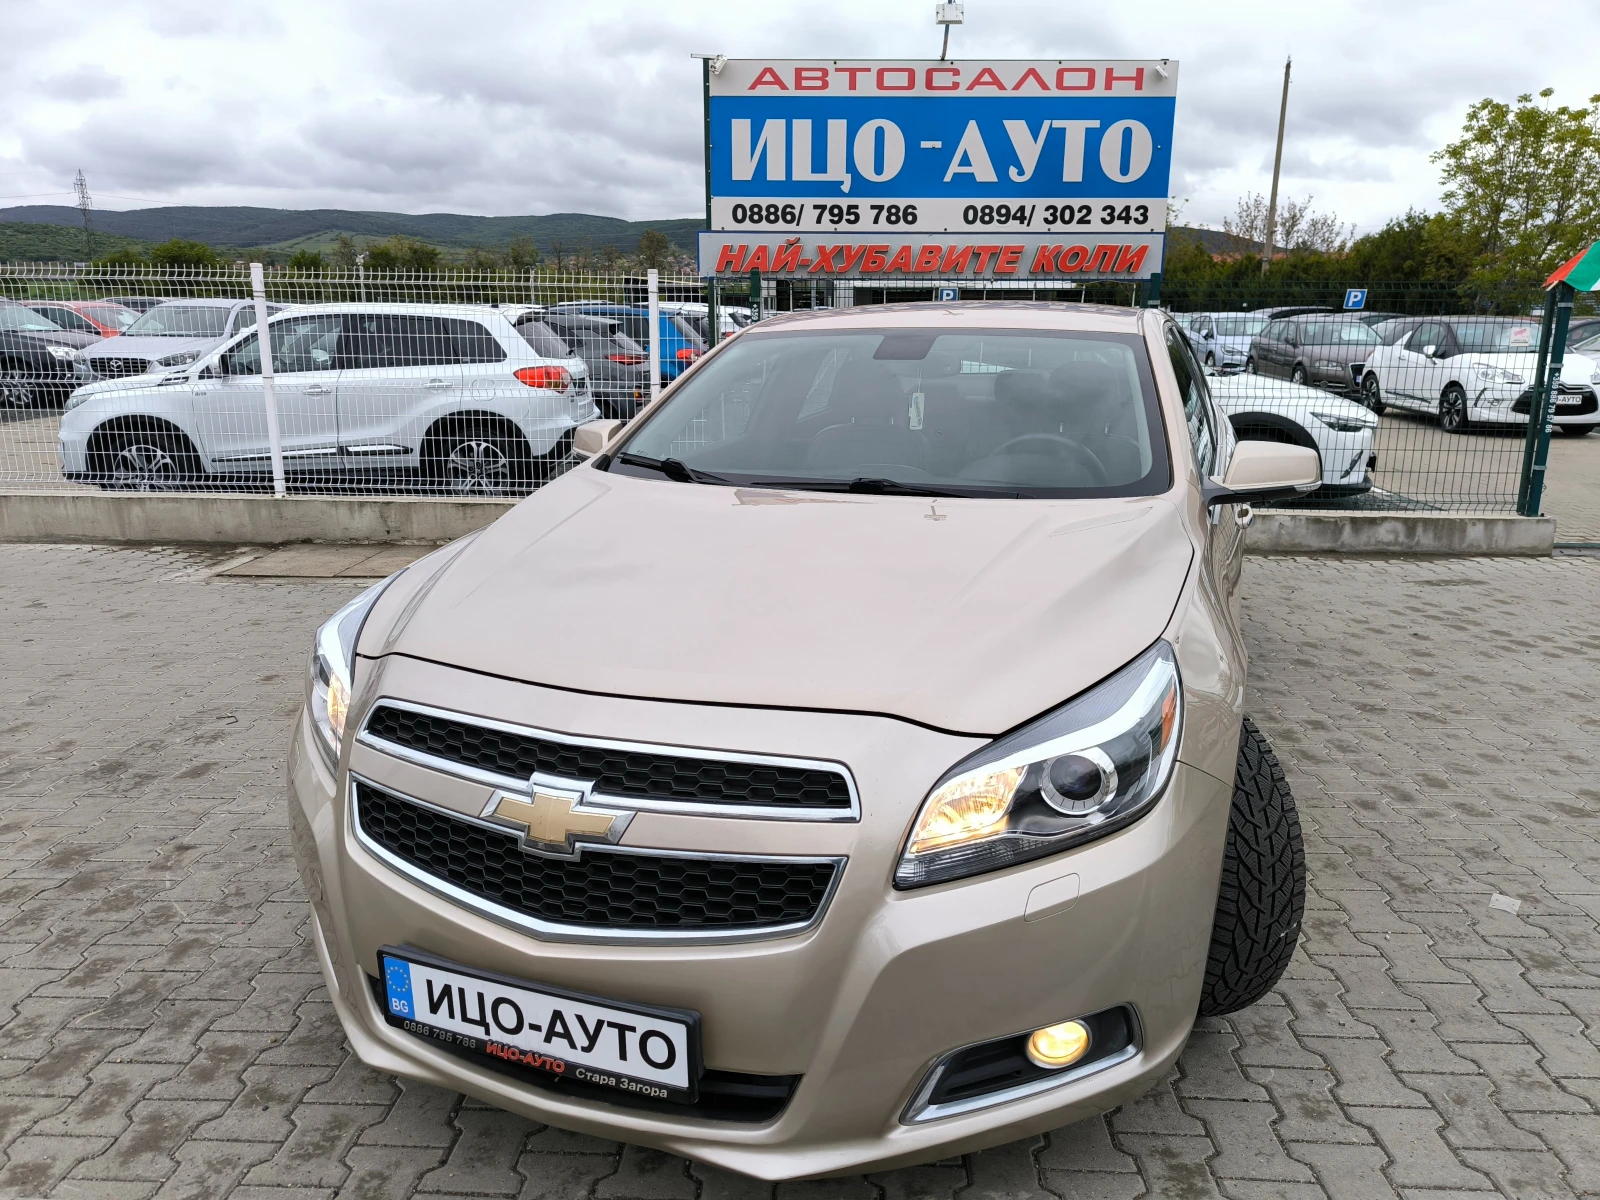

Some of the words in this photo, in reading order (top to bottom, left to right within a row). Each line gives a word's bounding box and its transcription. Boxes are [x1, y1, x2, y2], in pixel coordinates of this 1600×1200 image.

[747, 67, 1145, 91] АВТОСАЛОН
[732, 203, 804, 226] 0886/
[813, 205, 860, 225] 795
[871, 205, 918, 225] 786
[962, 204, 1036, 226] 0894/
[1043, 205, 1092, 225] 302
[1100, 205, 1149, 225] 343
[714, 237, 1025, 273] НАЙ-ХУБАВИТЕ
[1030, 243, 1150, 273] КОЛИ
[1348, 291, 1362, 307] P
[1551, 372, 1560, 389] +359
[391, 998, 409, 1014] BG
[425, 979, 676, 1070] ИЦО-АУТО
[403, 1020, 429, 1036] 0886
[432, 1029, 454, 1043] 795
[455, 1034, 476, 1049] 786
[486, 1041, 566, 1074] ИЦО-АУТО
[575, 1067, 616, 1088] Стара
[619, 1079, 669, 1100] Загора
